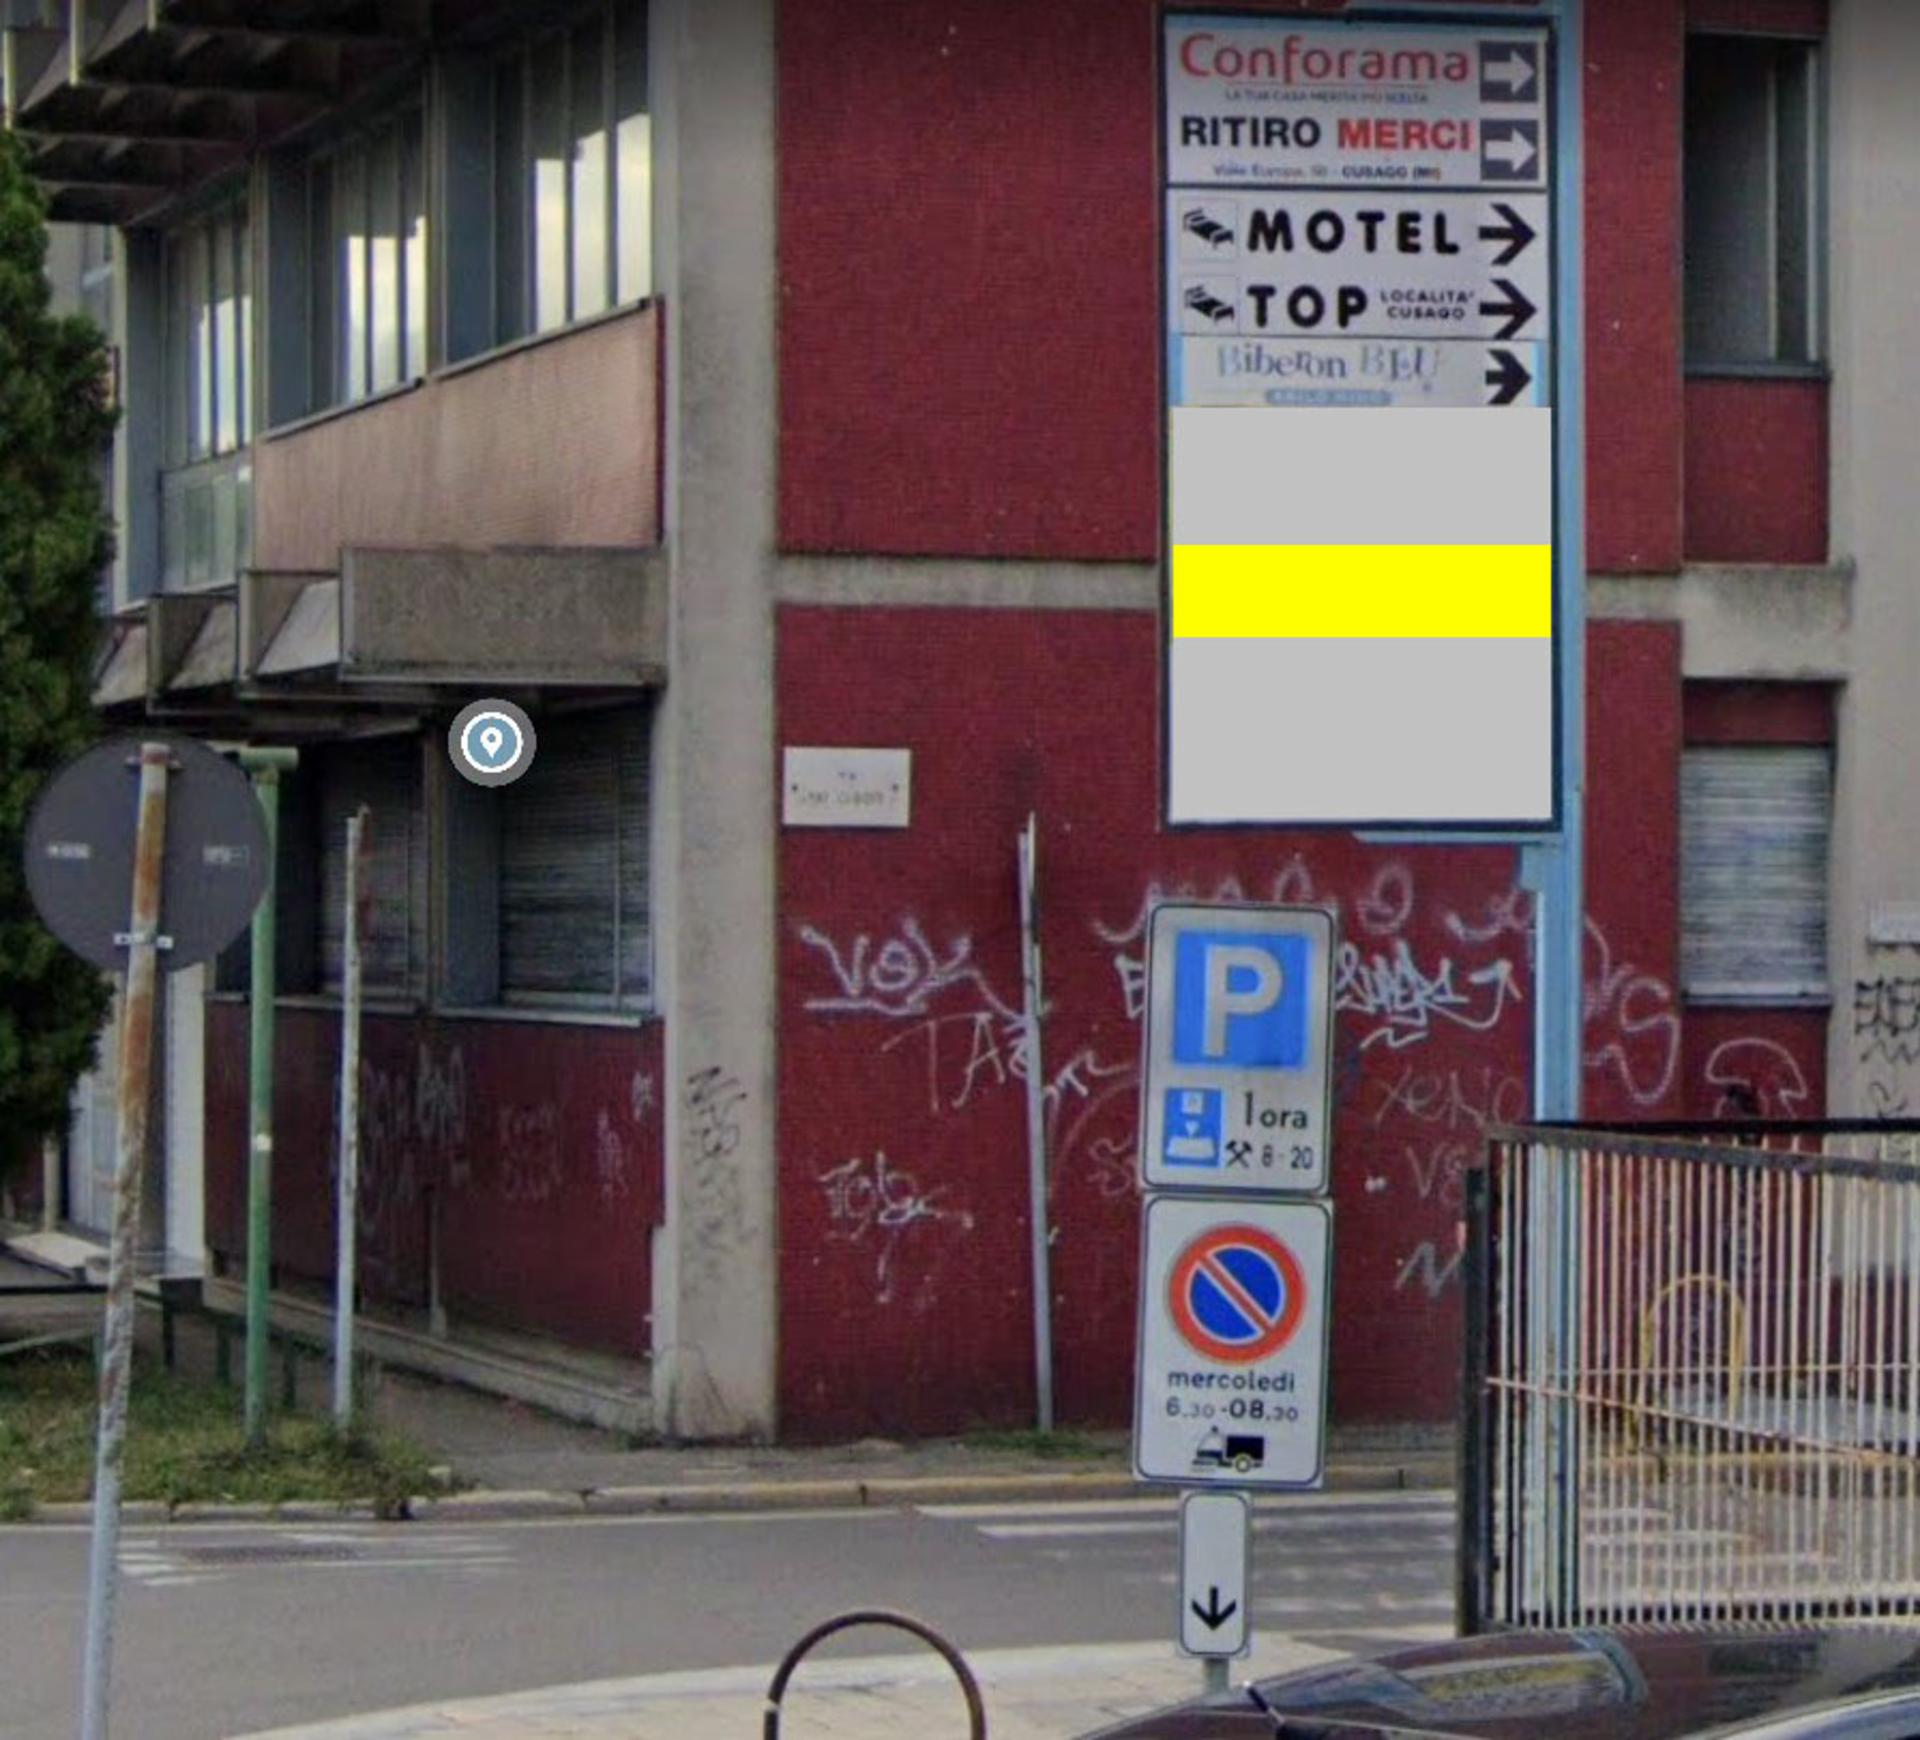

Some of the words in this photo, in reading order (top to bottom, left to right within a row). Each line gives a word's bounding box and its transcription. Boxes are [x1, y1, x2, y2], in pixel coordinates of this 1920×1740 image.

[1180, 33, 1469, 84] Conforama
[1181, 116, 1321, 148] RITIRO
[1337, 119, 1471, 151] MERCI
[1342, 165, 1408, 178] CUSAGO
[1247, 209, 1460, 254] MOTEL
[1246, 285, 1368, 328] TOP
[1387, 305, 1466, 320] CUSAGO
[1205, 944, 1282, 1058] P
[1260, 1107, 1308, 1128] ora
[1261, 1144, 1274, 1167] 8
[1290, 1146, 1314, 1169] 20
